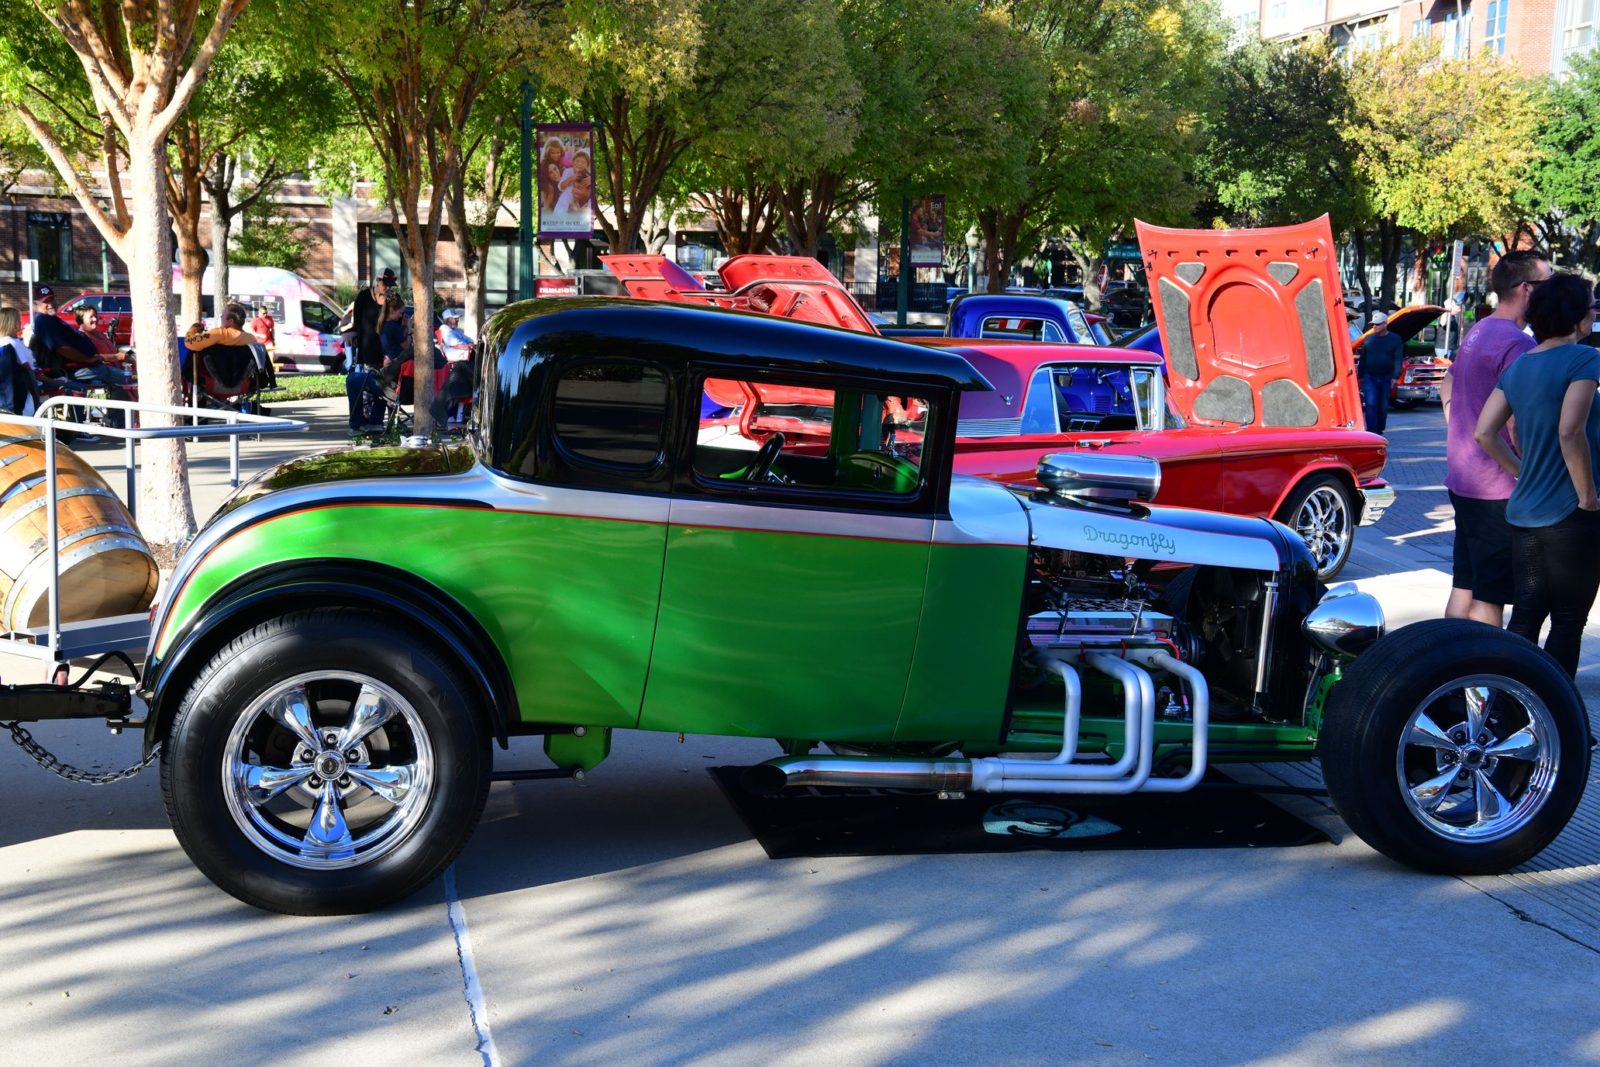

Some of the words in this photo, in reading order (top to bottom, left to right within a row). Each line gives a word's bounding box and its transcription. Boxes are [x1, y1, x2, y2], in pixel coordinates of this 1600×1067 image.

[562, 135, 589, 149] Play
[930, 201, 942, 209] Eat
[1083, 524, 1176, 555] Dragonfly
